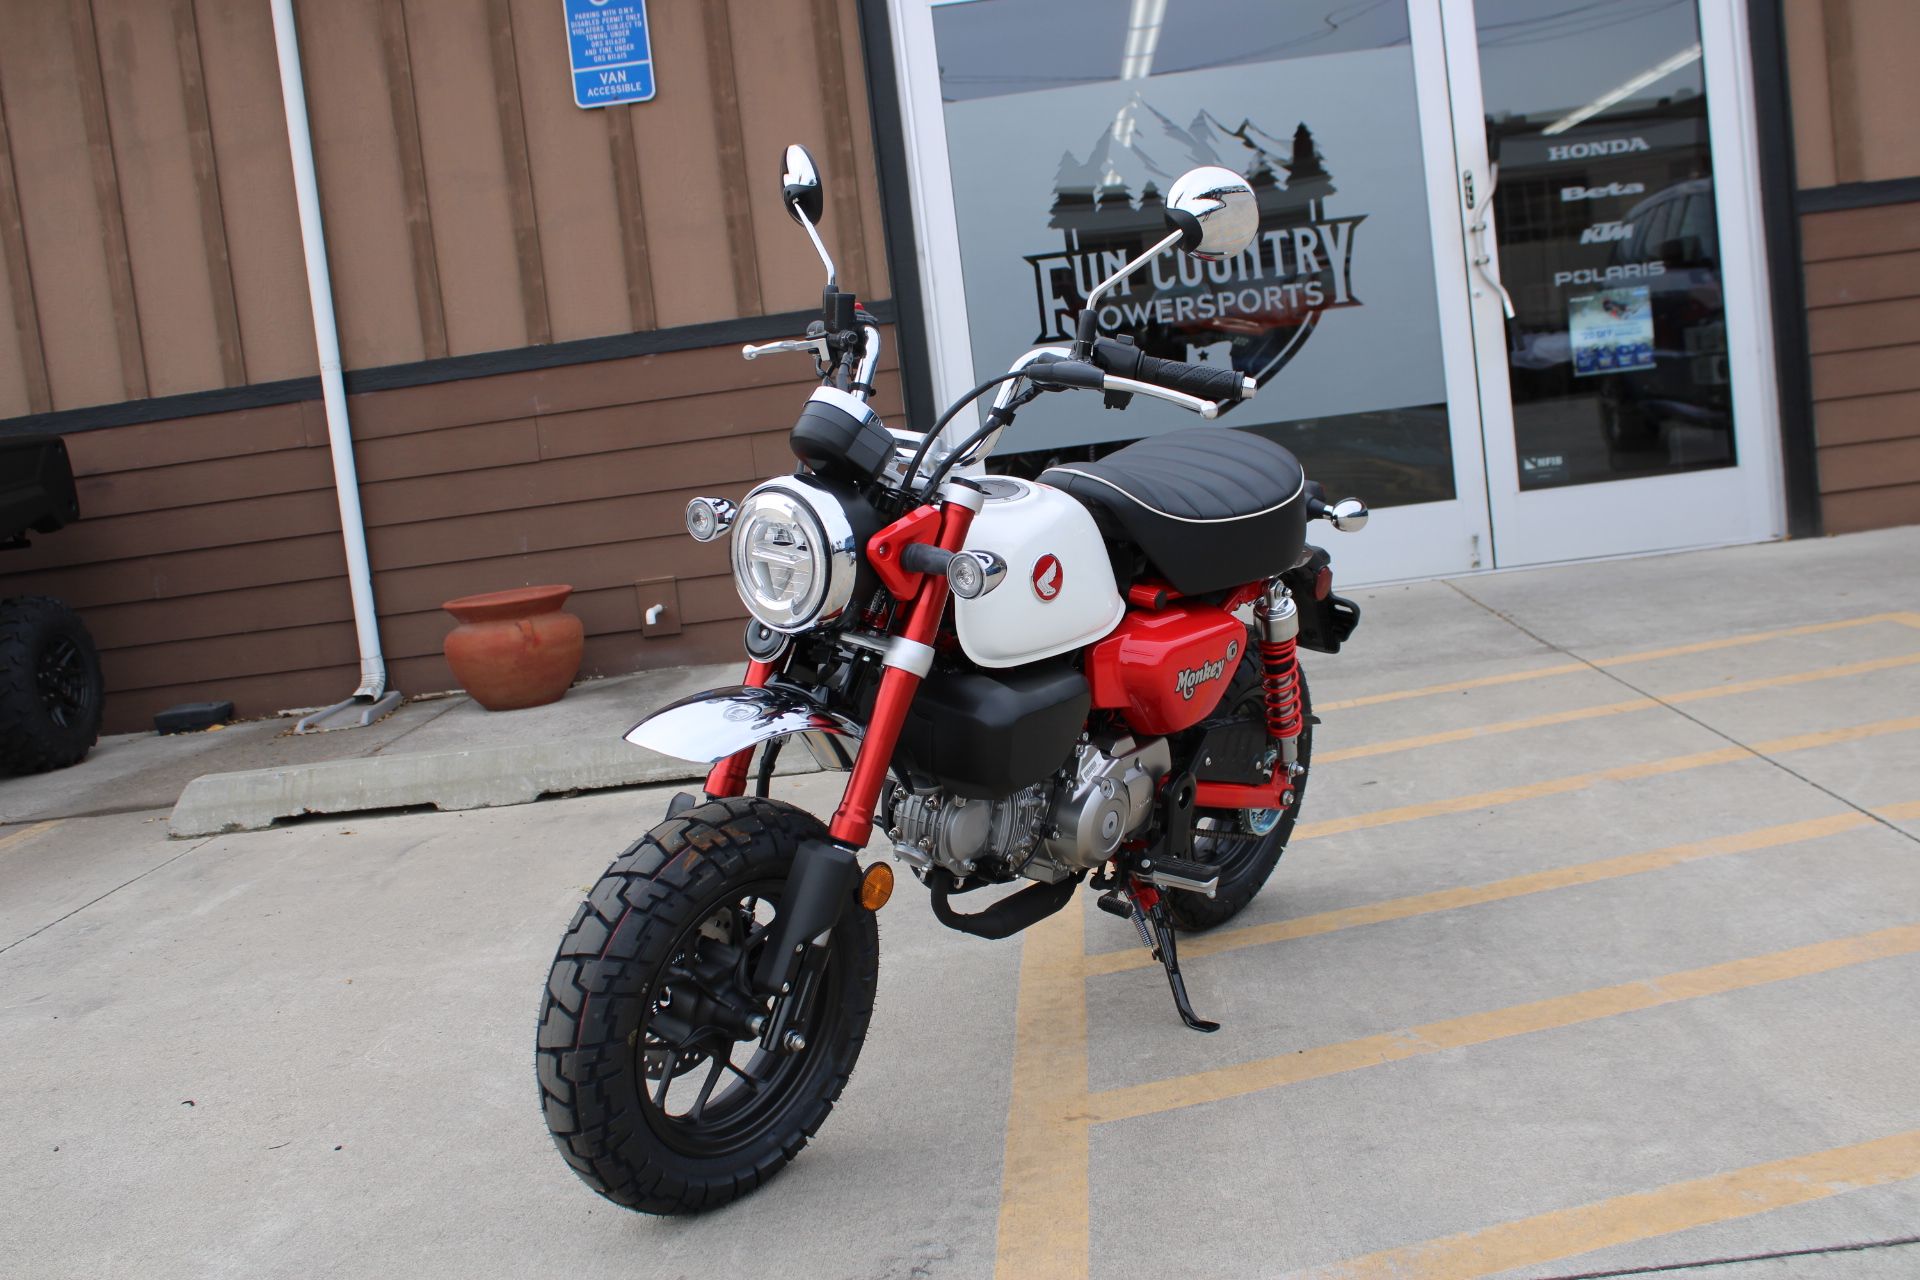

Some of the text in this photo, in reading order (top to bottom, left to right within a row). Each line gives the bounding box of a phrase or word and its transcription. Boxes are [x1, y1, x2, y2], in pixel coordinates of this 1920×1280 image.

[571, 13, 641, 28] DISABLED PERMIT ONLY
[602, 8, 616, 17] WITH
[607, 22, 632, 31] SUBJECT
[635, 20, 642, 28] TO
[586, 29, 630, 41] TOWING UNDER
[585, 43, 635, 56] AND FINE UNDER
[599, 70, 627, 85] VAN
[587, 81, 642, 97] ACCESSIBLE
[1548, 137, 1650, 161] HONDA
[1561, 182, 1645, 202] Beta
[1580, 221, 1635, 244] KTM
[1036, 221, 1354, 338] FUN COUNTRY
[1554, 260, 1666, 287] POLARIS
[1090, 281, 1325, 331] OWERSPORTS
[1175, 658, 1225, 700] Monkey
